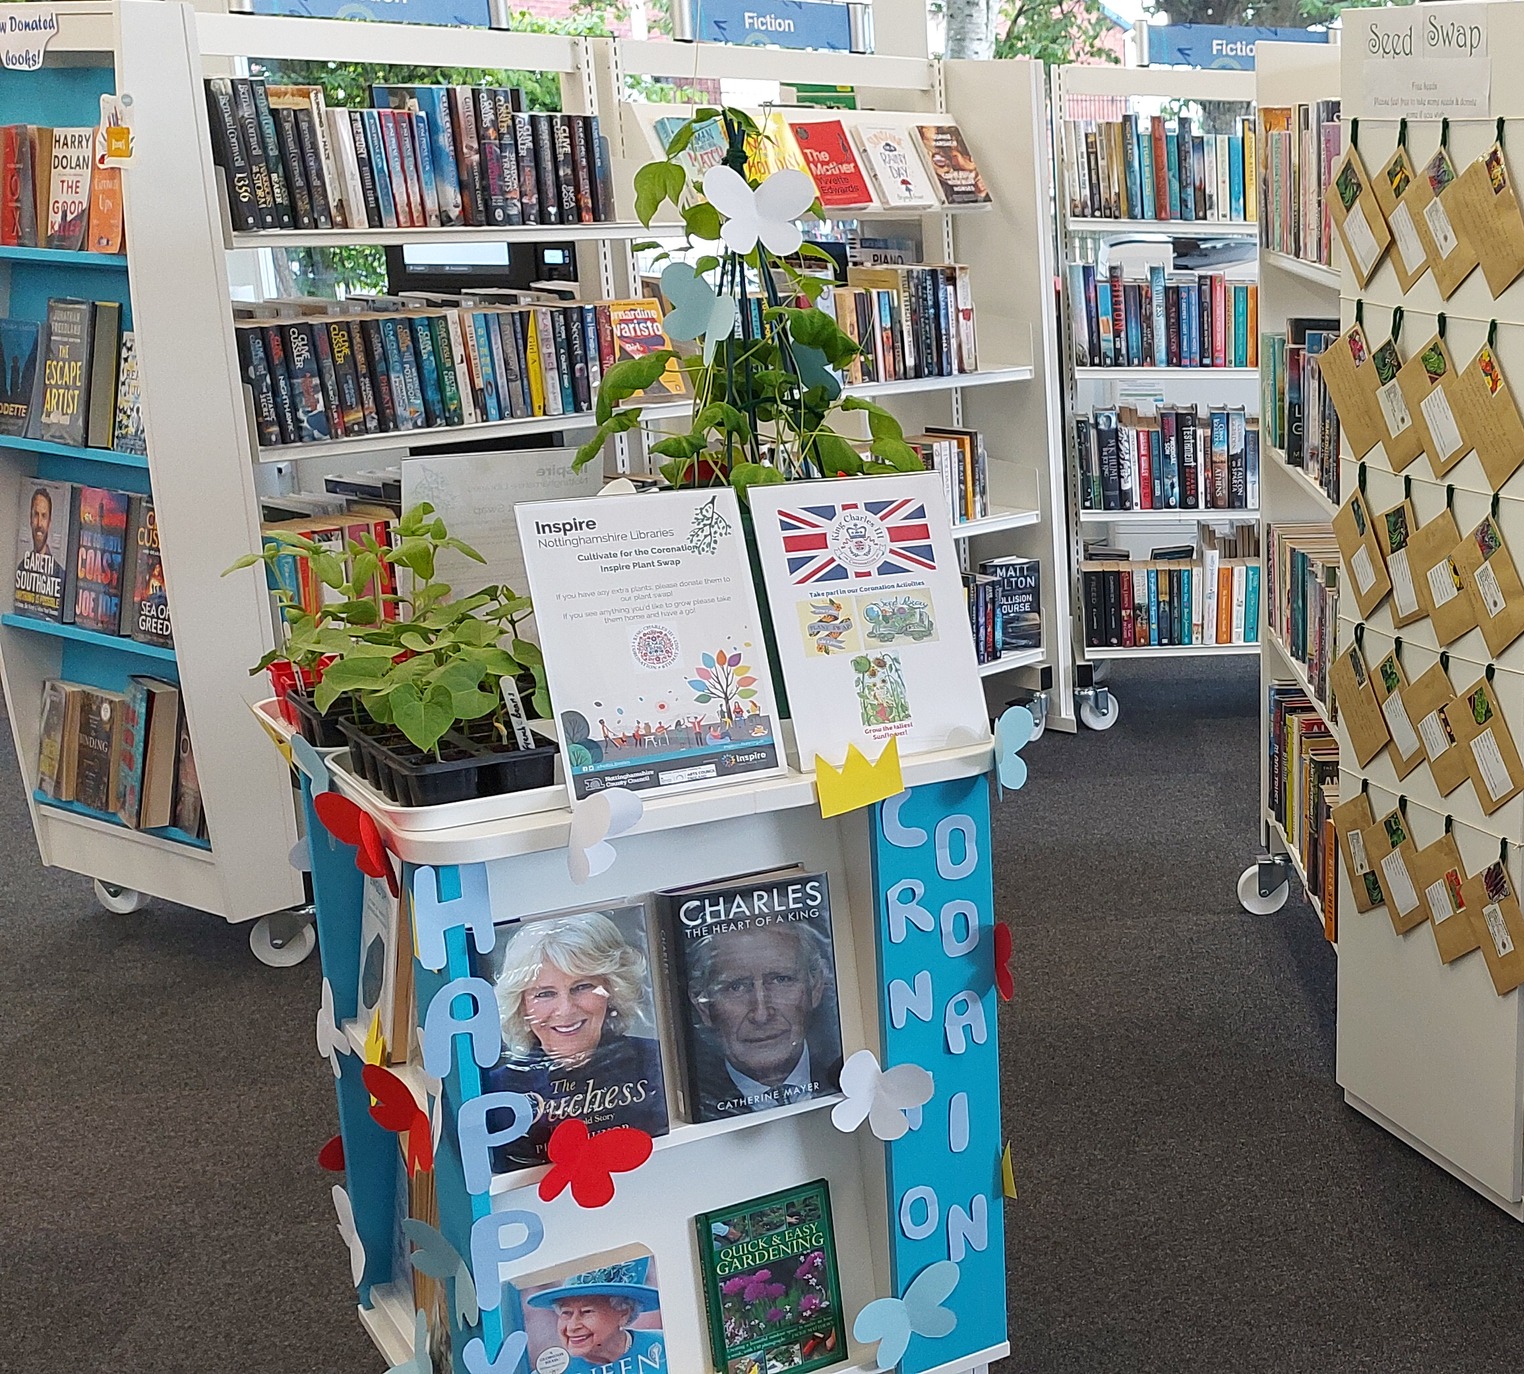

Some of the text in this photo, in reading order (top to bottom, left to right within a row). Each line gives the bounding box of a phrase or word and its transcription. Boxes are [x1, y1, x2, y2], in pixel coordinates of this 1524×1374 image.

[9, 15, 56, 33] Donated
[743, 12, 794, 34] Fiction
[1368, 15, 1481, 59] Seed Swap
[1212, 40, 1255, 56] Fictio
[5, 50, 41, 68] books!
[54, 133, 91, 150] HARRY
[53, 155, 89, 170] DOLAN
[806, 149, 829, 163] The
[880, 151, 908, 167] RAINY
[809, 162, 855, 176] Mother
[890, 164, 910, 179] DAY
[60, 180, 80, 194] THE
[234, 173, 253, 203] 1356
[817, 177, 850, 187] Yvette
[52, 201, 84, 215] GOOD
[59, 344, 69, 359] THE
[45, 361, 82, 386] ESCAPE
[44, 389, 79, 414] ARTIST
[278, 375, 294, 433] NIGHTHAWK
[535, 517, 597, 536] Inspire
[831, 512, 885, 542] King Charles III
[538, 528, 675, 549] Nottinghamshire Libraries
[577, 543, 699, 562] Cultivate for the Coronation
[24, 551, 54, 575] GARETH
[600, 558, 681, 573] Inspire Plant Swap
[996, 564, 1029, 578] MATT
[15, 570, 61, 598] SOUTHGATE
[561, 593, 577, 602] you
[577, 590, 596, 599] have
[654, 581, 678, 591] please
[679, 578, 703, 588] donate
[704, 576, 722, 585] them
[809, 591, 825, 599] Take
[826, 589, 839, 598] part
[859, 582, 895, 593] Coronation
[141, 601, 157, 616] SEA
[138, 615, 171, 636] GREED
[864, 727, 882, 736] Grow
[882, 725, 893, 733] the
[736, 751, 767, 765] Inspire
[679, 881, 822, 927] CHARLES
[685, 908, 820, 939] THE HEART OF A KING
[551, 1078, 576, 1094] The
[717, 1081, 820, 1111] CATHERINE MAYER
[720, 1222, 819, 1262] QUICK & EASY
[716, 1232, 825, 1276] GARDENING
